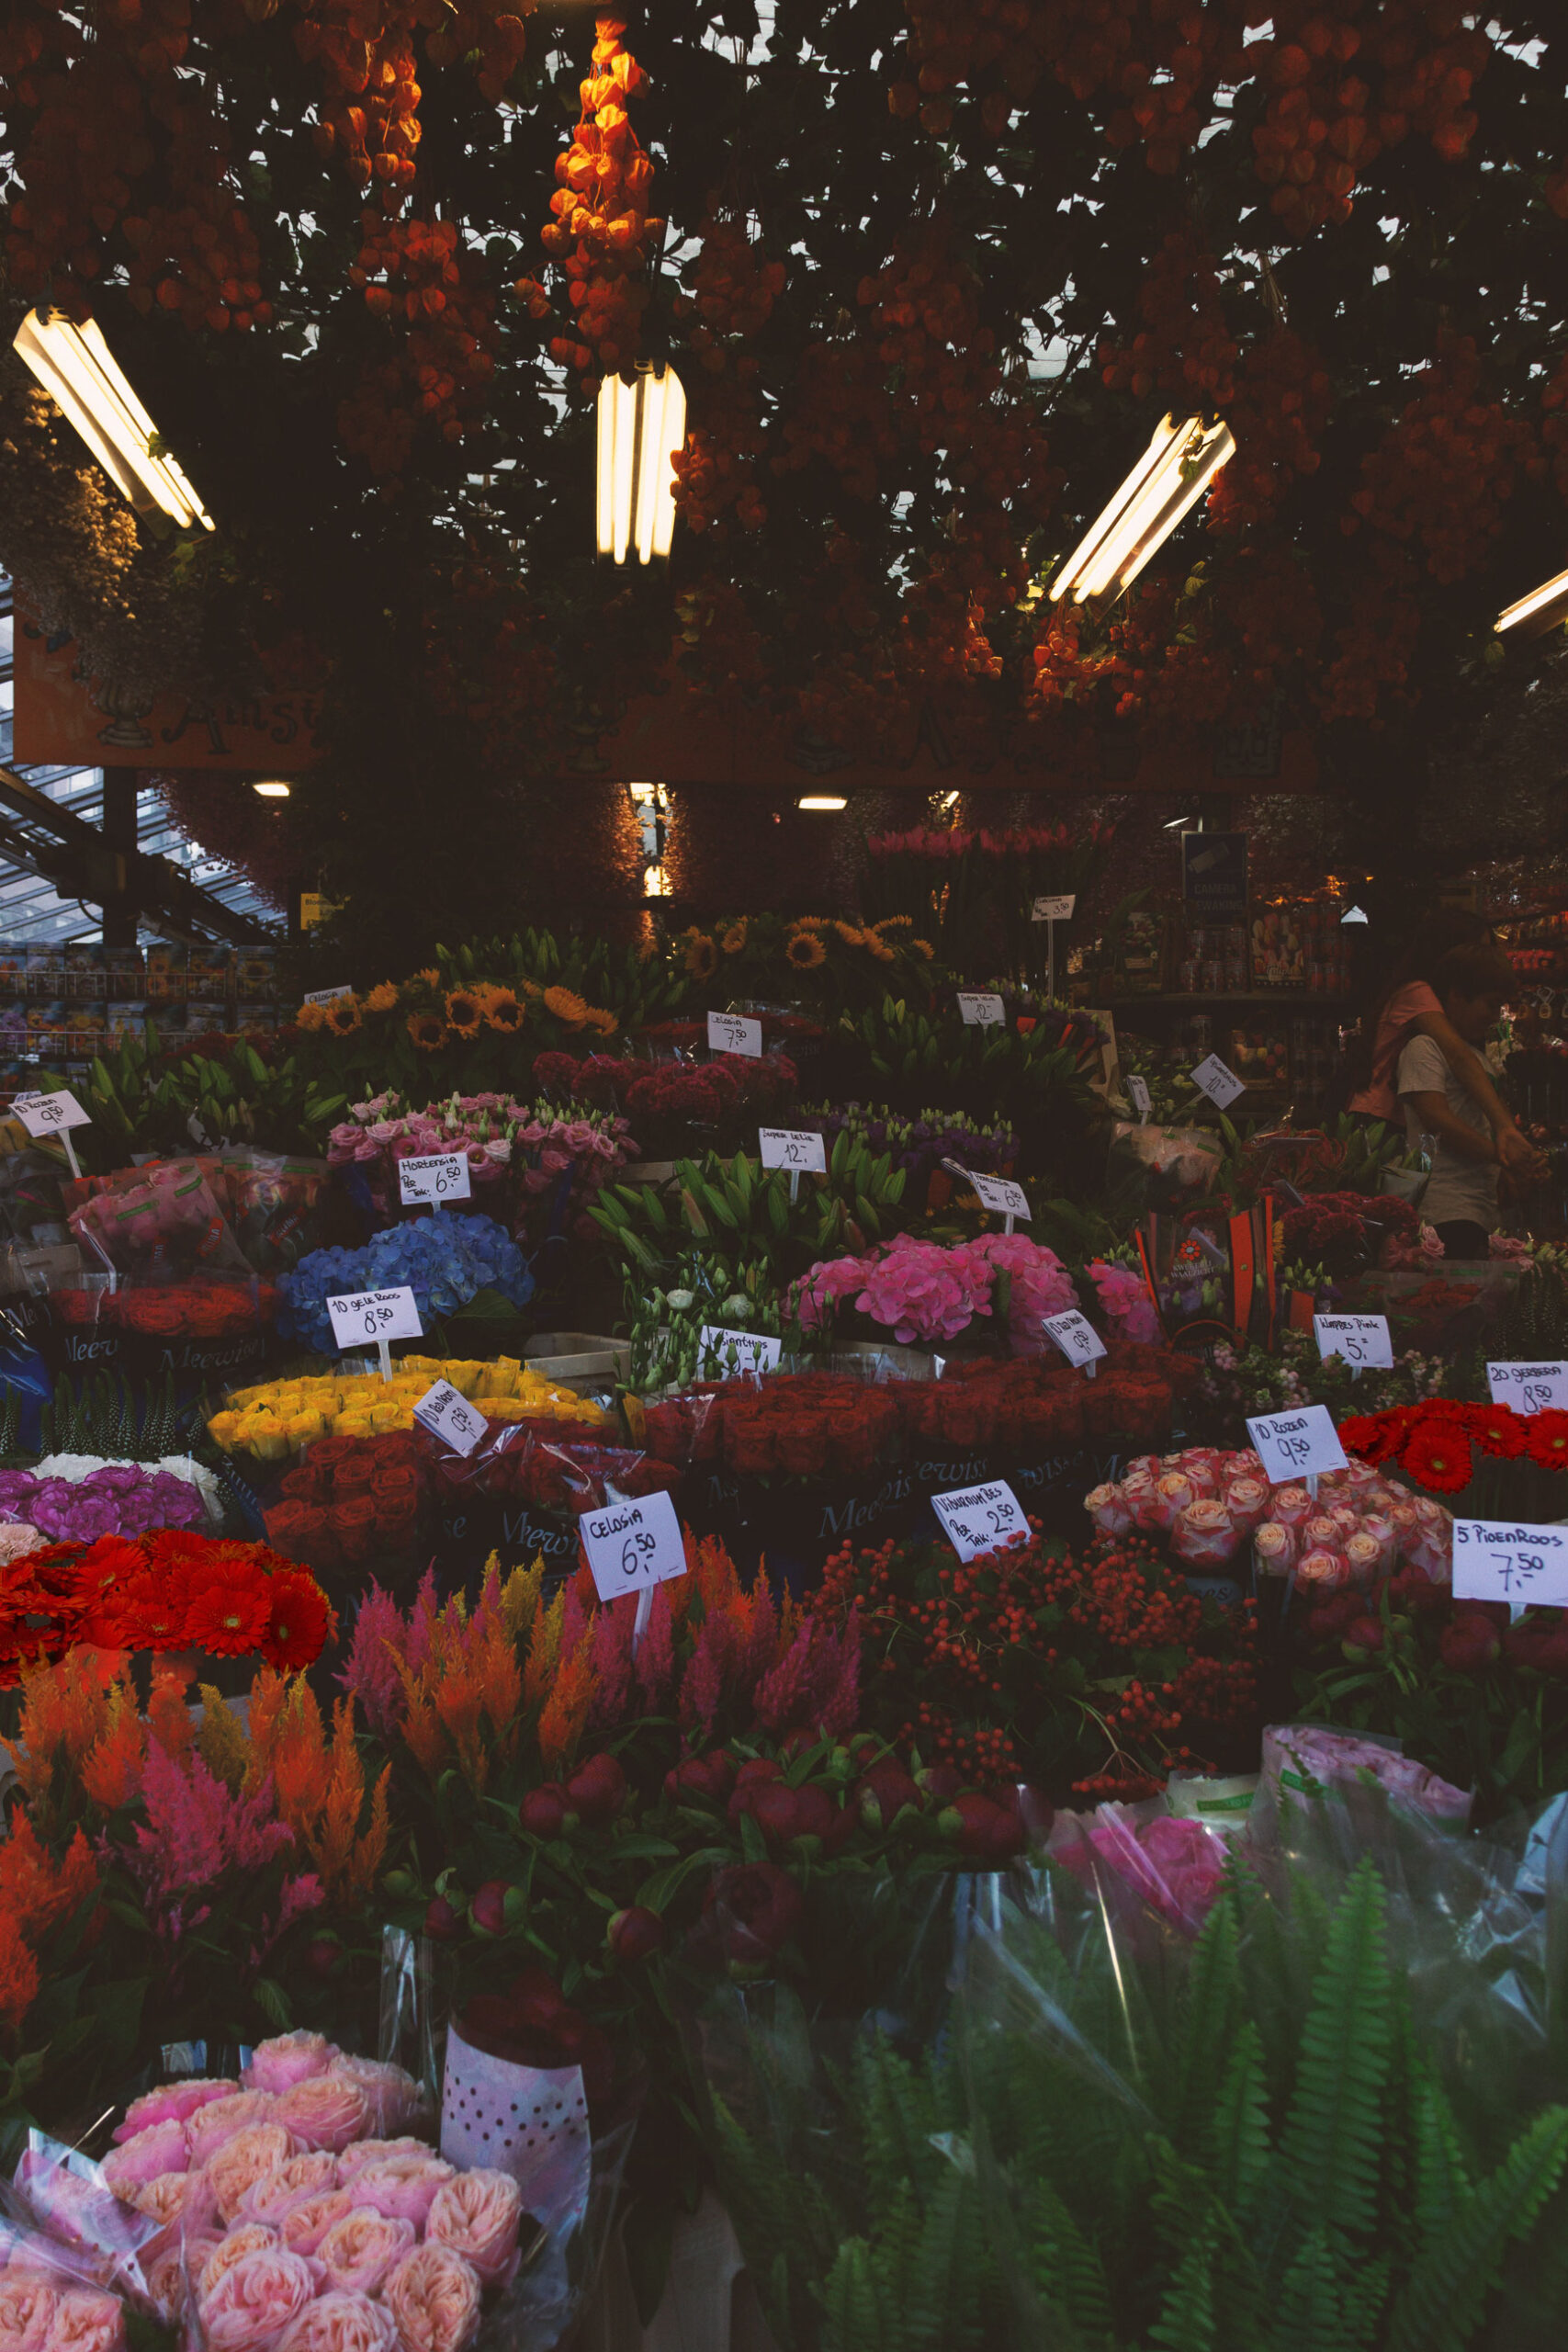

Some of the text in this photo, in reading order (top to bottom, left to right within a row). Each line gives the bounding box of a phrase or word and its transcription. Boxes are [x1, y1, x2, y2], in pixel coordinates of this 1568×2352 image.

[332, 1300, 348, 1314] 10
[1490, 1366, 1509, 1382] 20
[1457, 1525, 1470, 1544] 5
